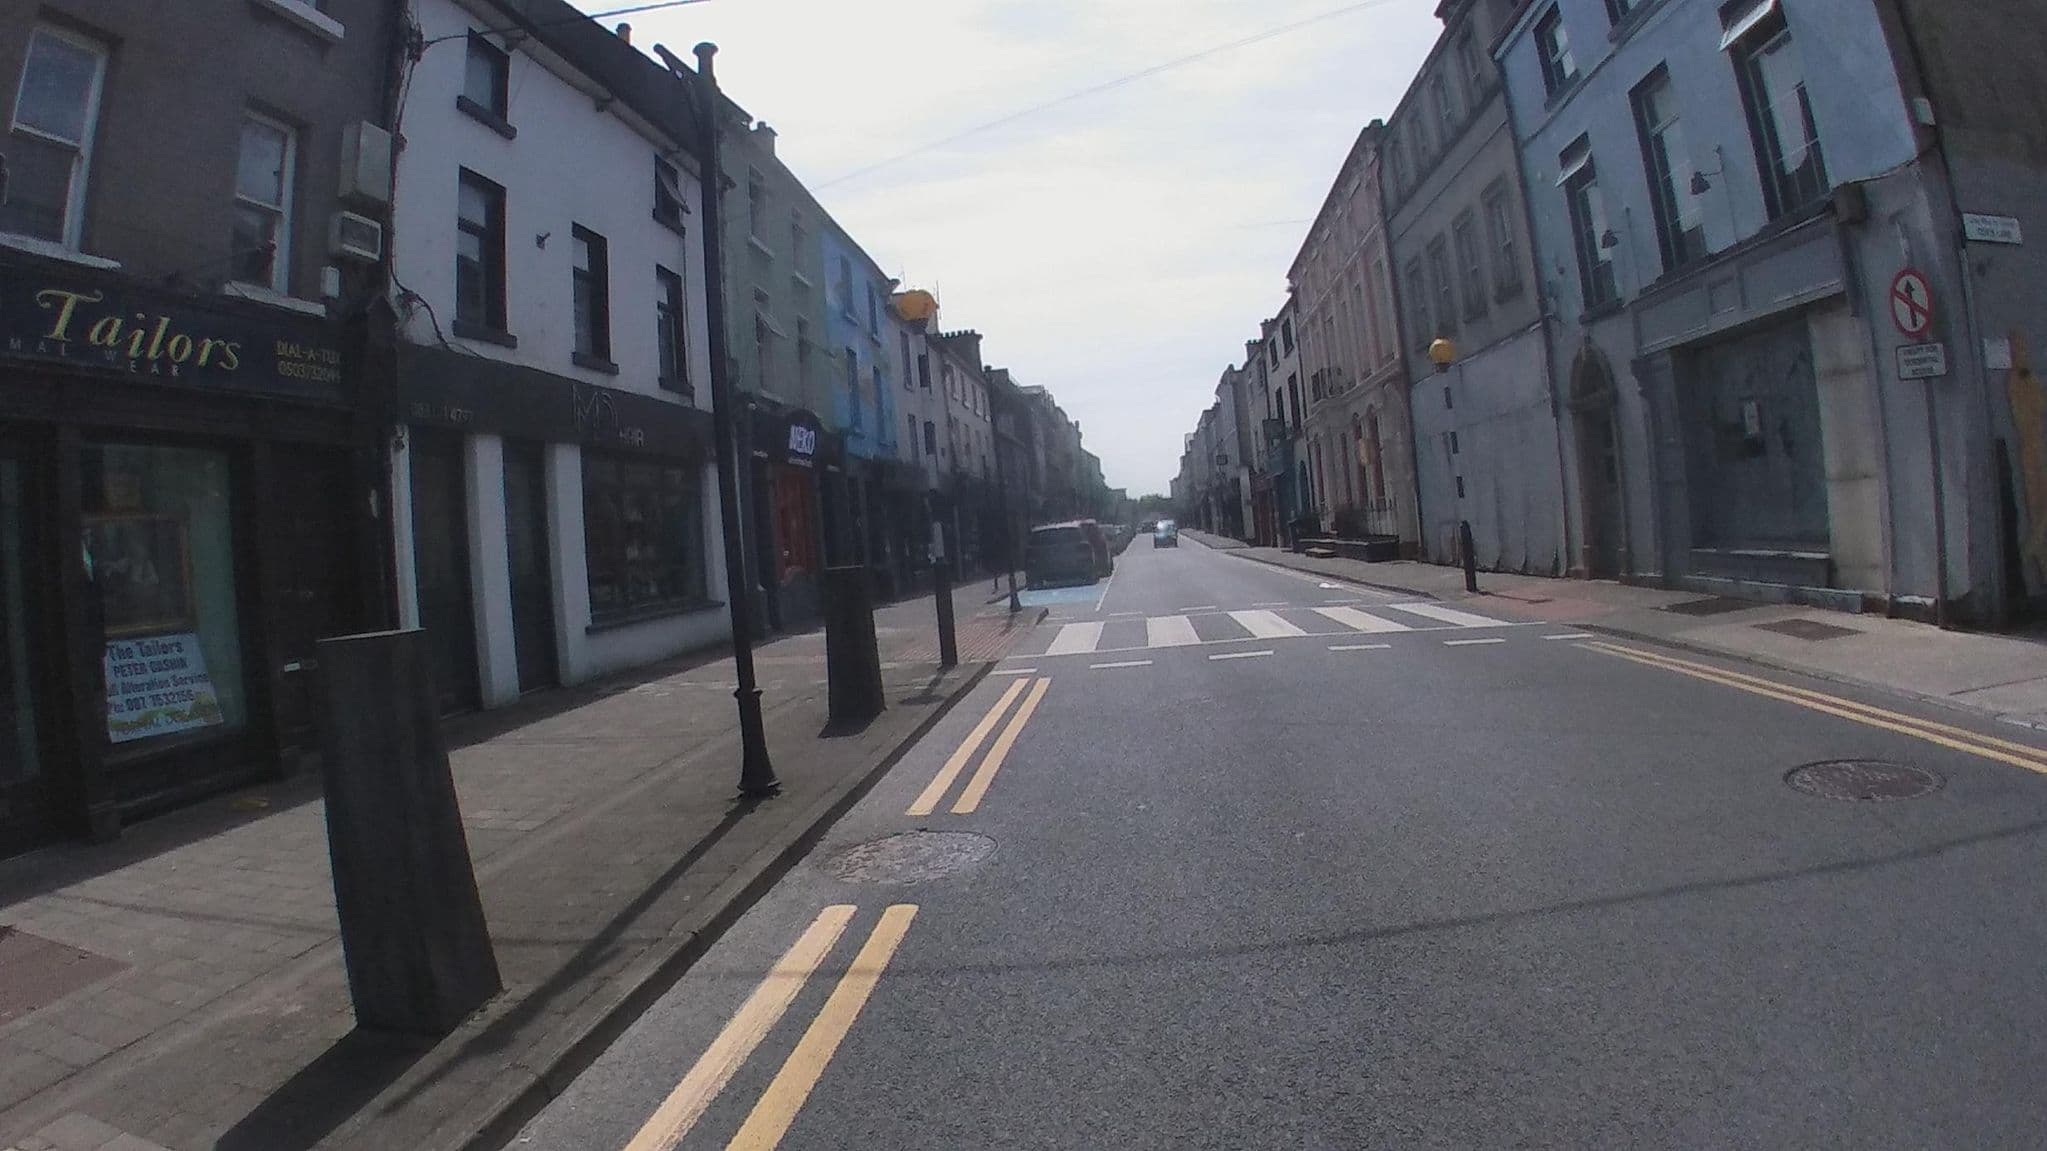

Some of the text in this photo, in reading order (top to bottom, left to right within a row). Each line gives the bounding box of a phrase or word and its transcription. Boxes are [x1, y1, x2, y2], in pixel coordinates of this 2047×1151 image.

[35, 289, 241, 370] Tailors
[104, 349, 181, 377] WEAR
[109, 640, 184, 661] The Tailors
[113, 662, 147, 677] PETER
